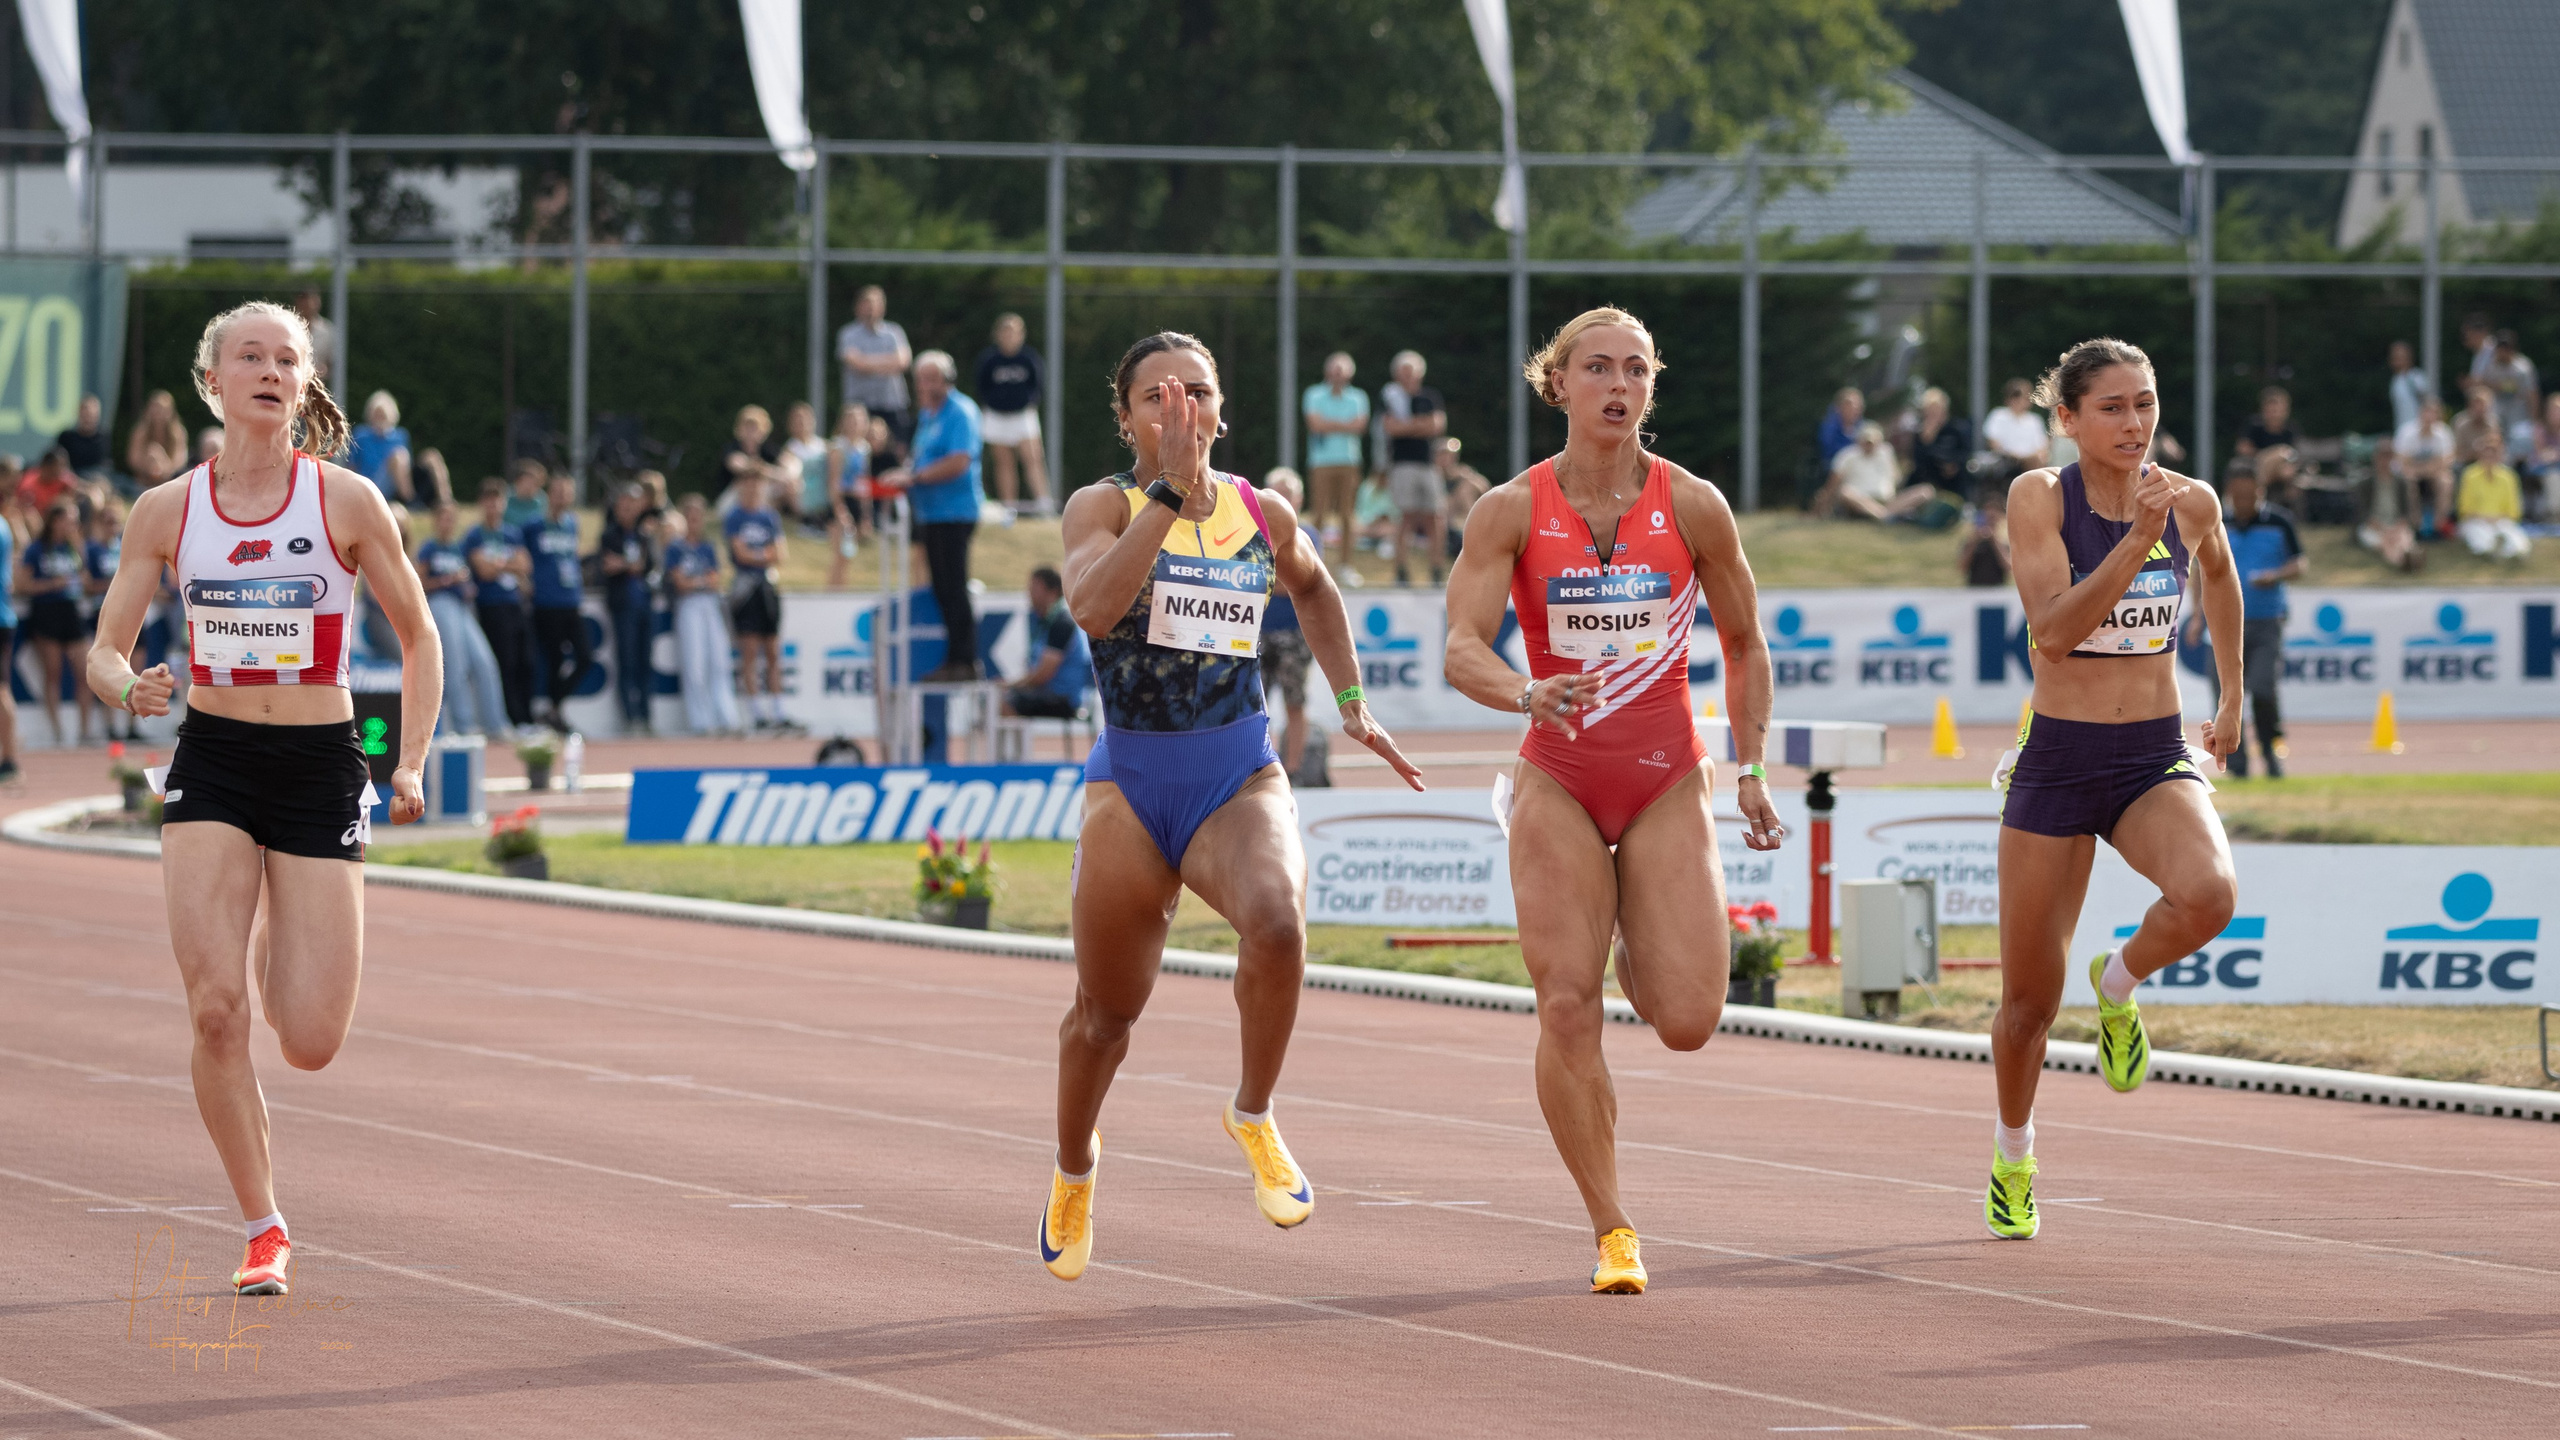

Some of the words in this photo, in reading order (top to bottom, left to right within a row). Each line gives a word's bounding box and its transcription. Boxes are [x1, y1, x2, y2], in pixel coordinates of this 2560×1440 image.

[1164, 594, 1255, 625] NKANSA
[1566, 611, 1651, 632] ROSIUS
[2100, 604, 2172, 629] AGAN
[205, 619, 299, 637] DHAENENS
[1198, 641, 1216, 650] KBC
[1362, 661, 1422, 688] BC
[1777, 658, 1832, 684] BC
[1860, 657, 1950, 684] KBC
[2284, 655, 2377, 681] KBC
[2403, 654, 2496, 681] KBC
[1317, 853, 1493, 882] Continental
[1316, 886, 1377, 911] Tour
[1383, 886, 1488, 912] Bronze
[2140, 948, 2263, 988] BC
[2379, 949, 2537, 991] KBC
